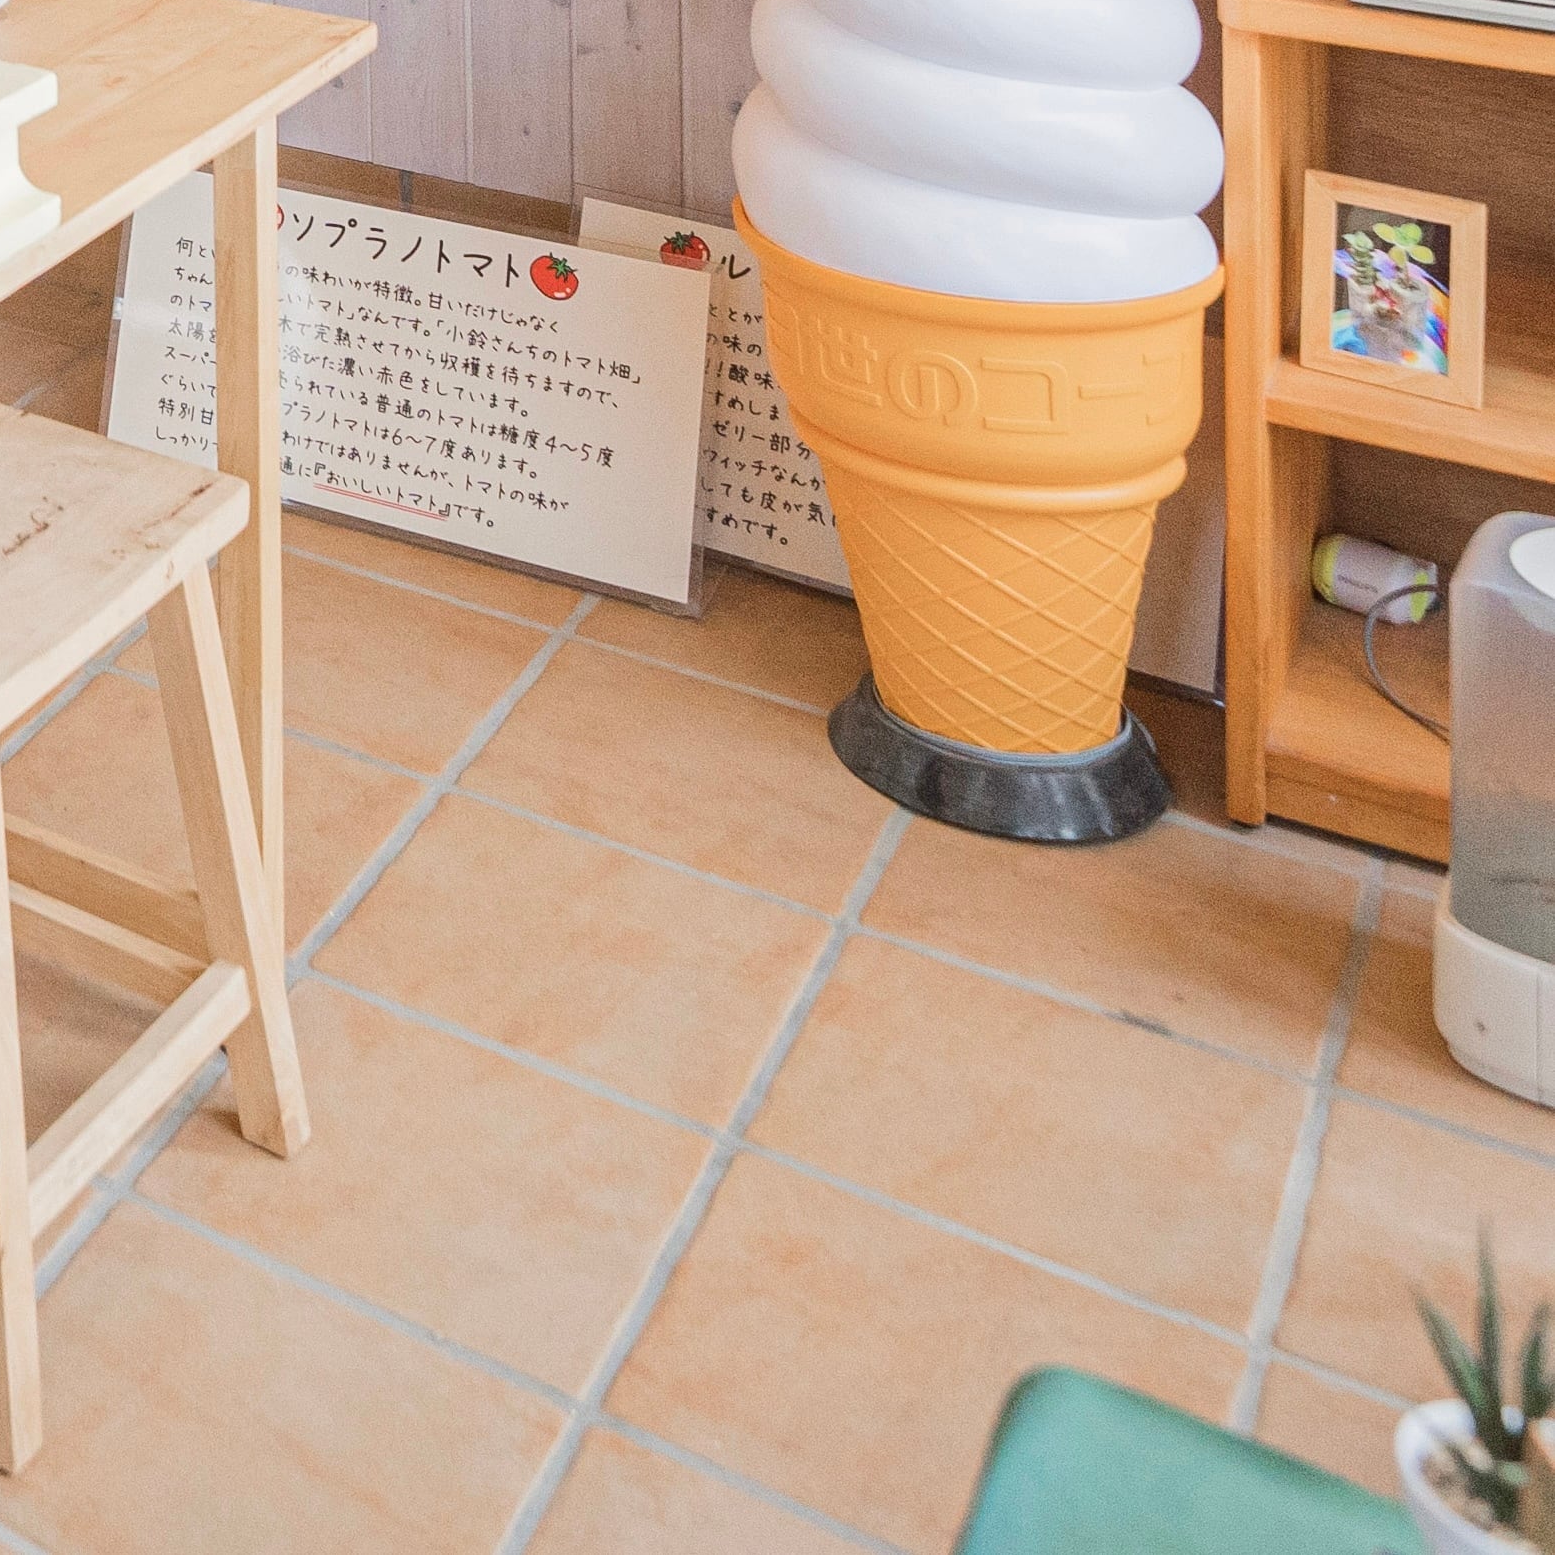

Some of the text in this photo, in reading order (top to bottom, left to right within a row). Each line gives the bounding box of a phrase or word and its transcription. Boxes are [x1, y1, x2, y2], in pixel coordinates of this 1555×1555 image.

[291, 207, 521, 291] ソプラノトマト
[279, 292, 643, 387] いトマト」なんです。「小鈴さんちのトマト畑」
[700, 476, 837, 527] しても皮が気
